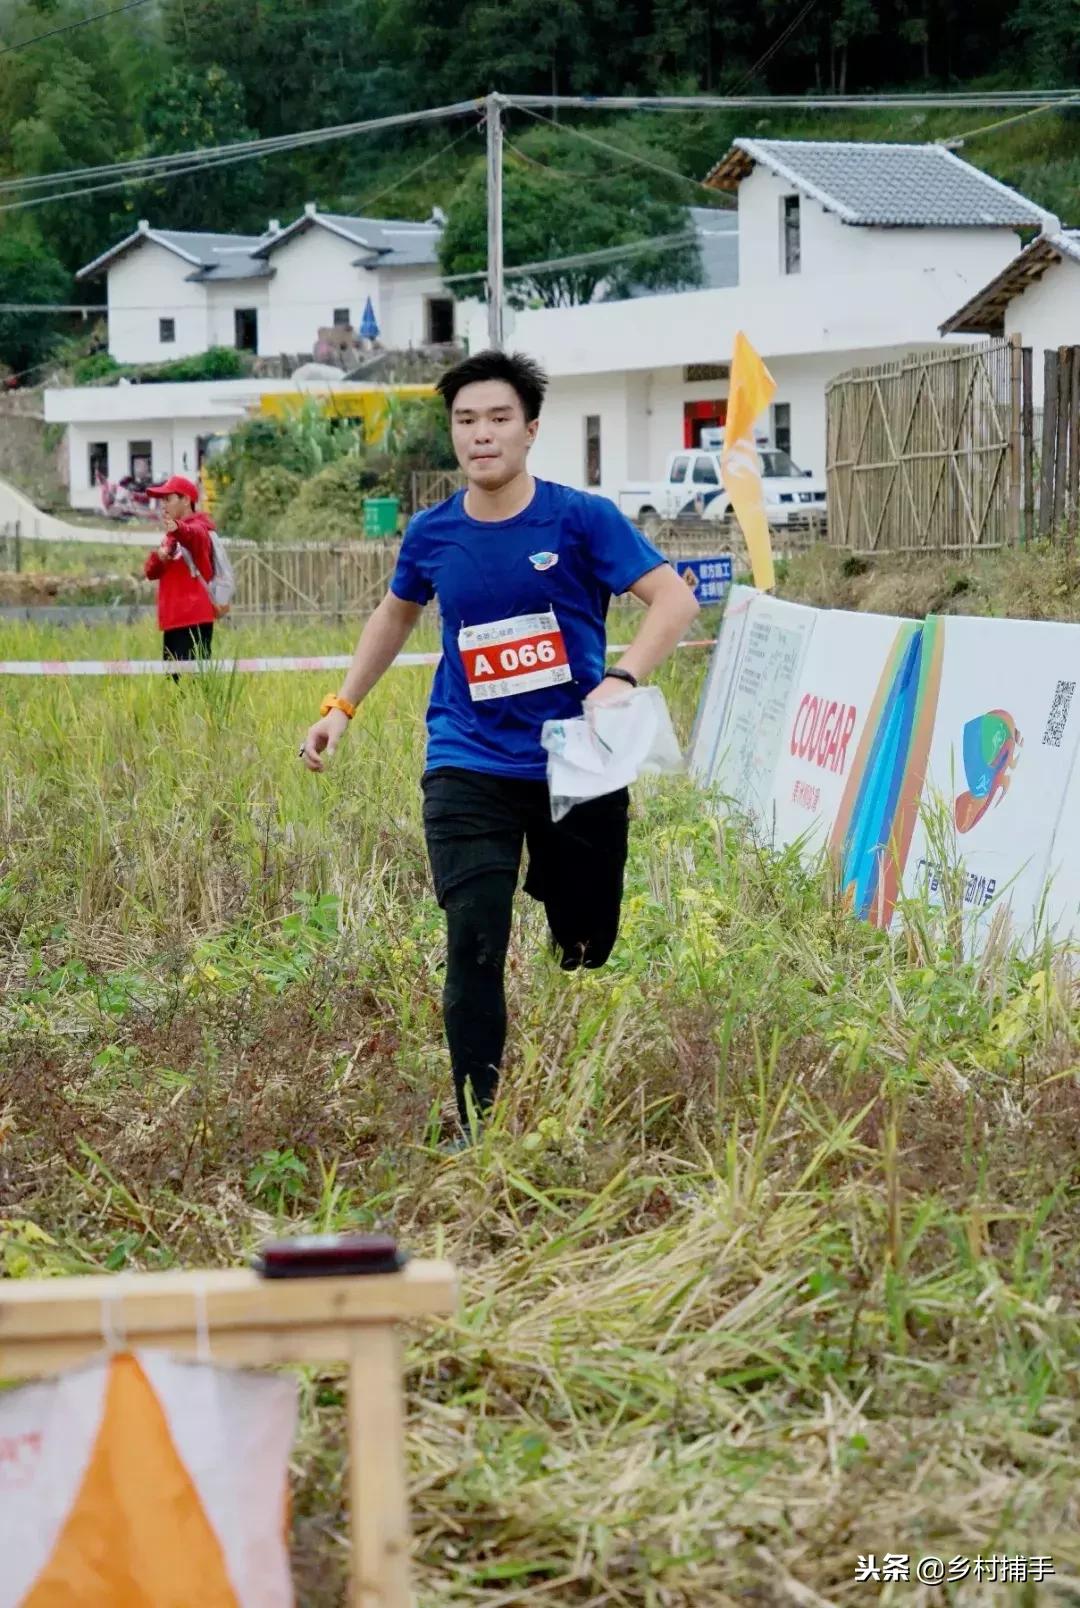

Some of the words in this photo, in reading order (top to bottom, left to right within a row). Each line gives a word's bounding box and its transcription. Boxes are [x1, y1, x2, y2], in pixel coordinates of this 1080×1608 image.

[474, 654, 496, 677] A
[500, 640, 556, 671] 066
[790, 693, 857, 776] COUGAR
